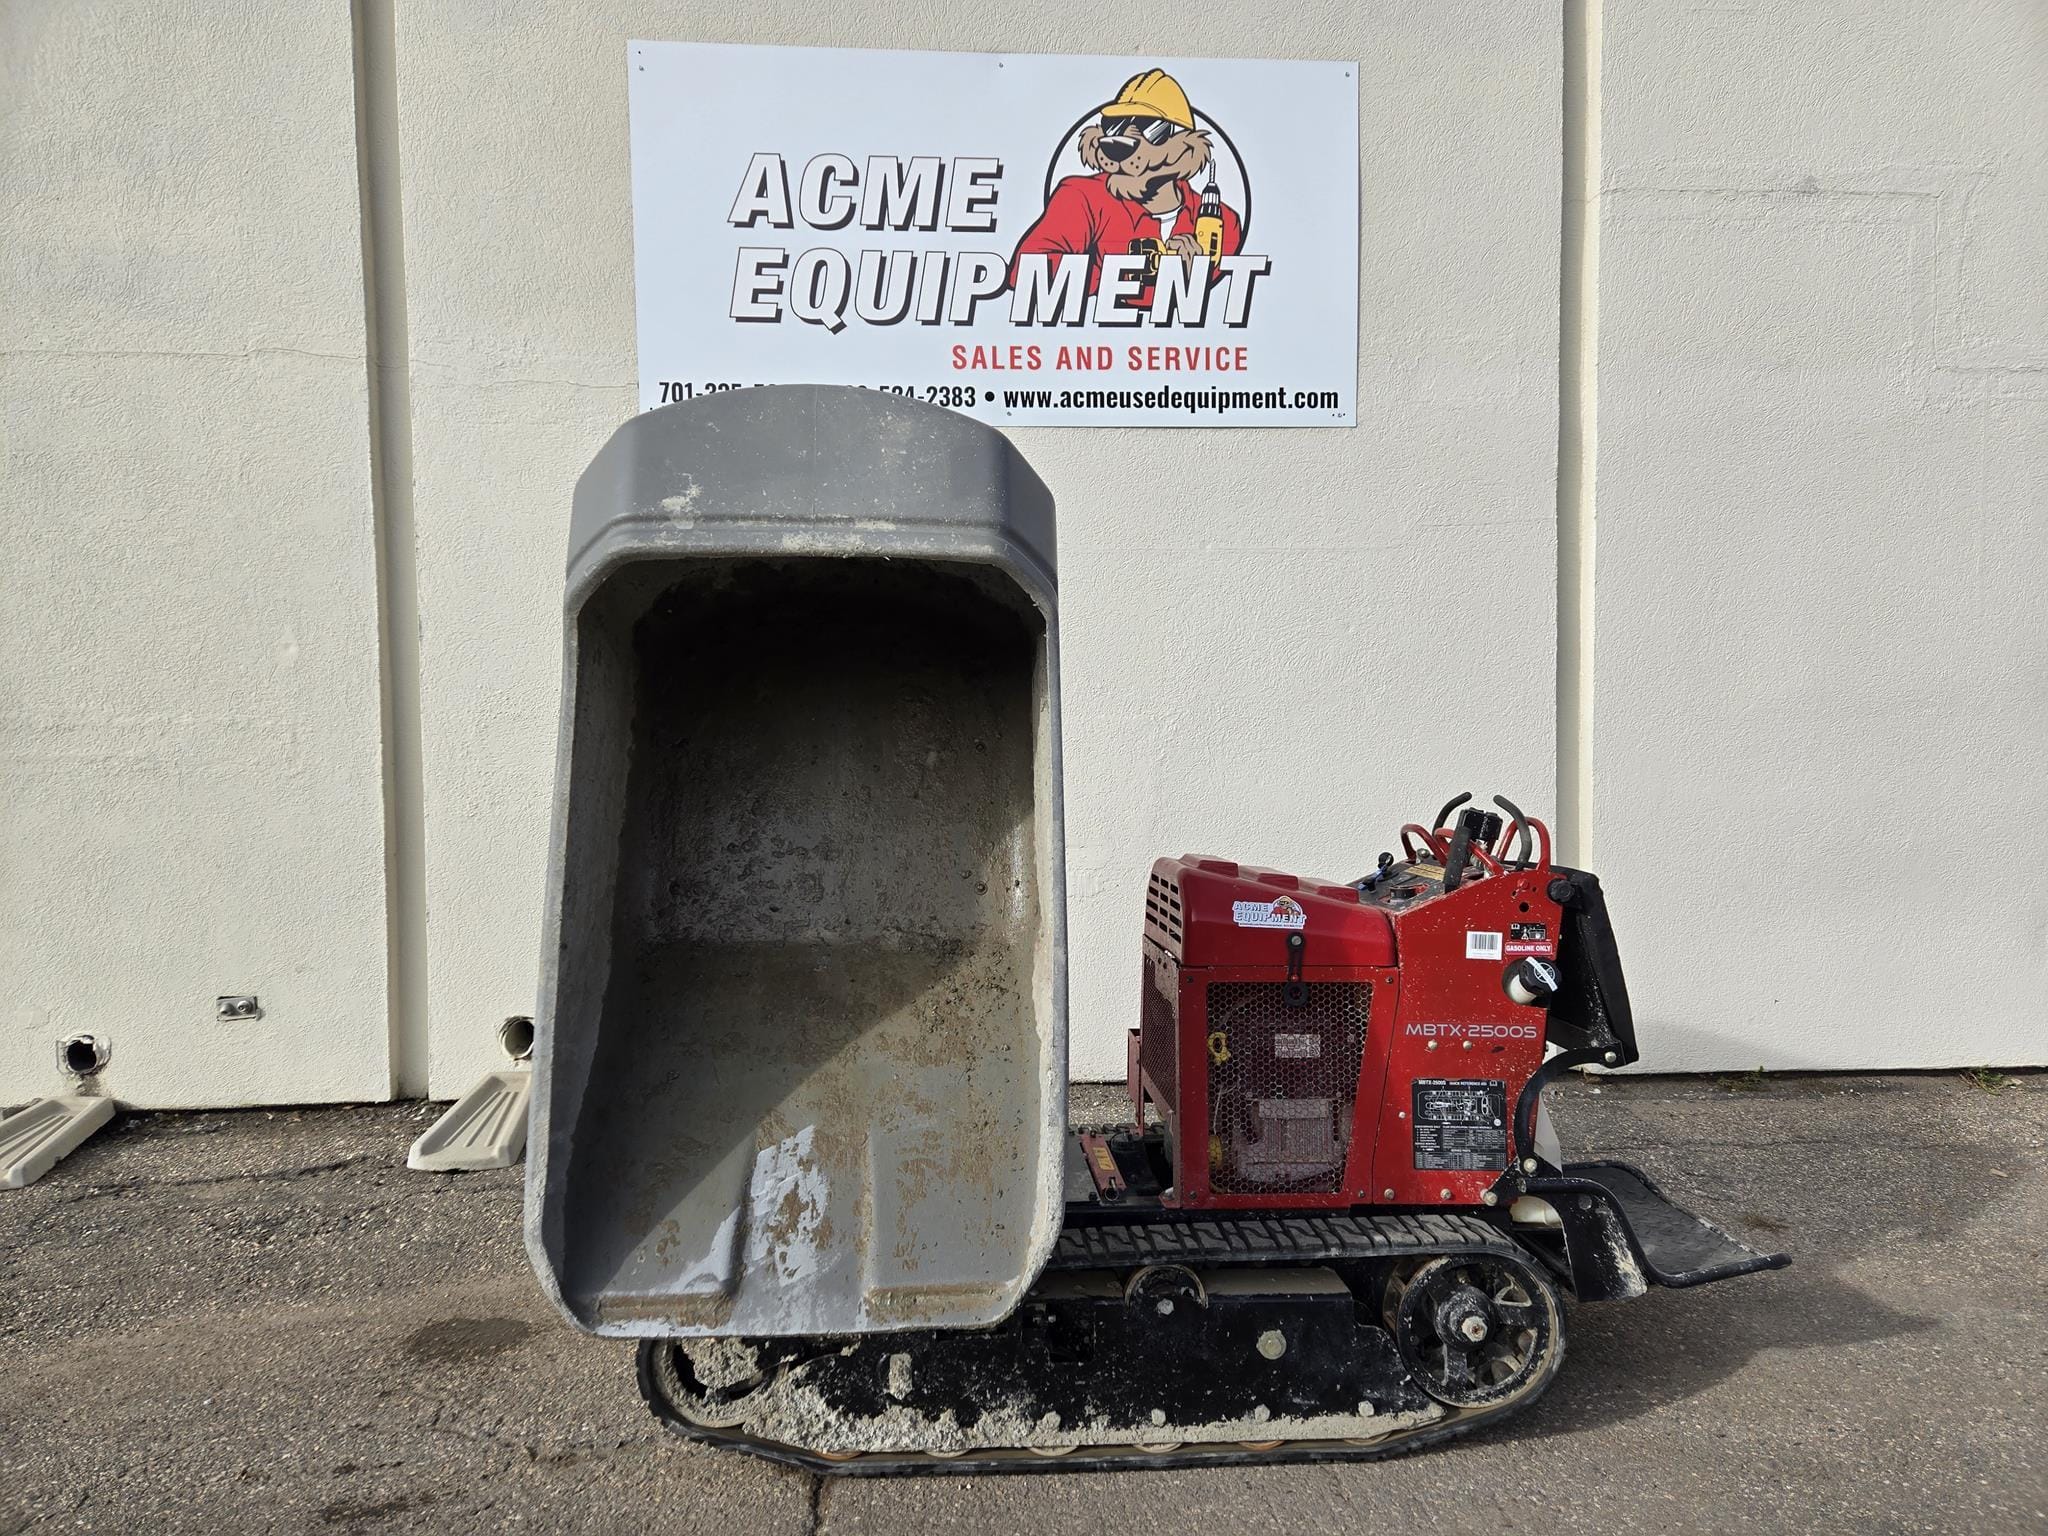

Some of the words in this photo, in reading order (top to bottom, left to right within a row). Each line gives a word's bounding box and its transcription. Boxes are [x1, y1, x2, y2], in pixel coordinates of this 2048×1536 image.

[727, 153, 1004, 232] ACME
[729, 247, 1272, 335] EQUIPMENT
[952, 345, 1042, 370] SALES
[1056, 346, 1113, 370] AND
[1128, 346, 1248, 371] SERVICE
[1003, 385, 1339, 413] www.acmeusedequipment.com
[1234, 902, 1269, 912] ACME
[1235, 911, 1305, 923] EQUIPMENT
